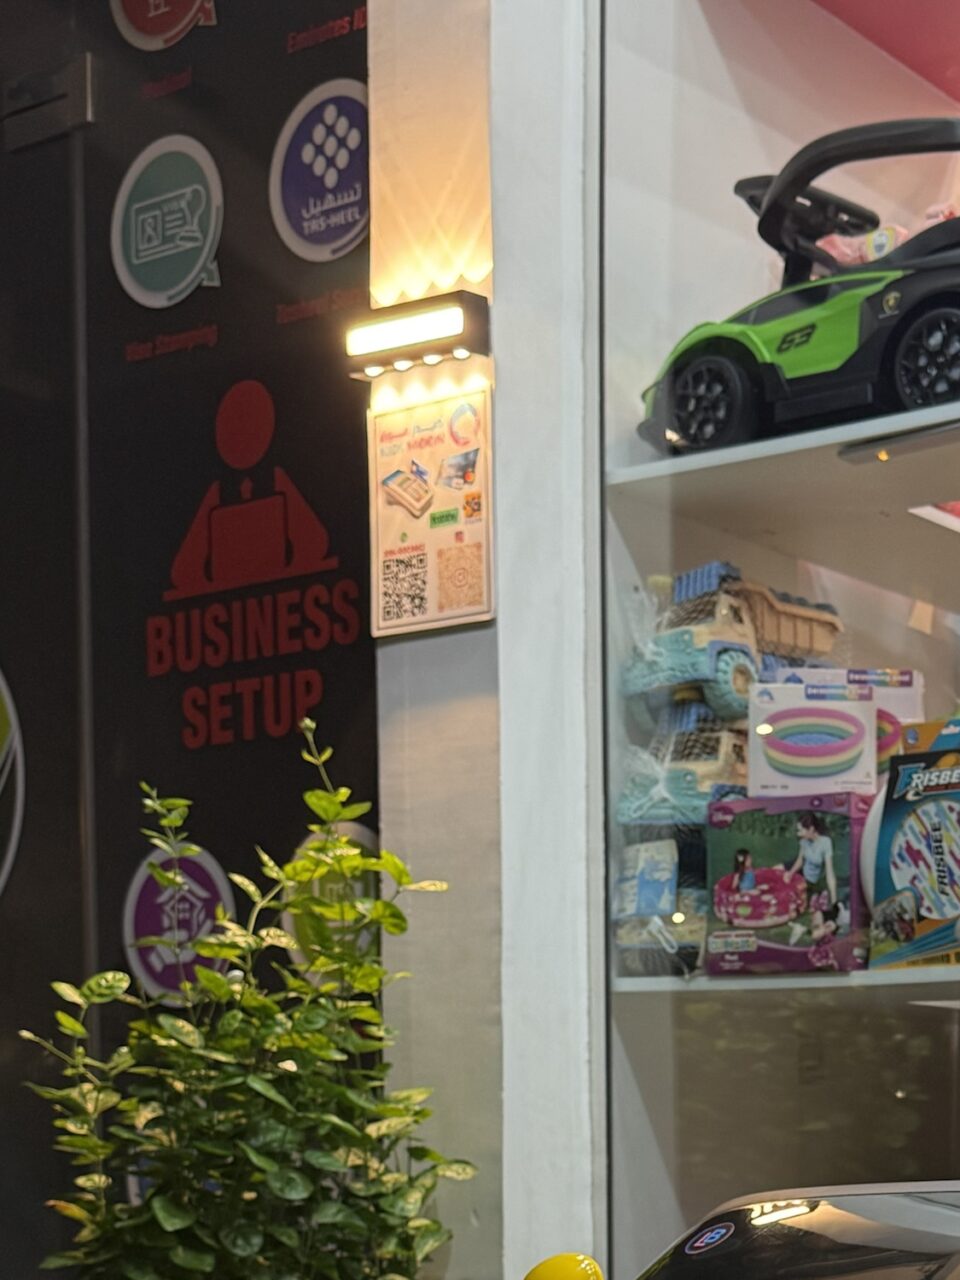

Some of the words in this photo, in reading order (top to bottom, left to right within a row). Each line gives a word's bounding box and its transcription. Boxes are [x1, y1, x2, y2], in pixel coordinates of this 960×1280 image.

[146, 578, 360, 678] BUSINESS
[182, 668, 323, 749] SETUP
[930, 819, 949, 897] FRISBEE
